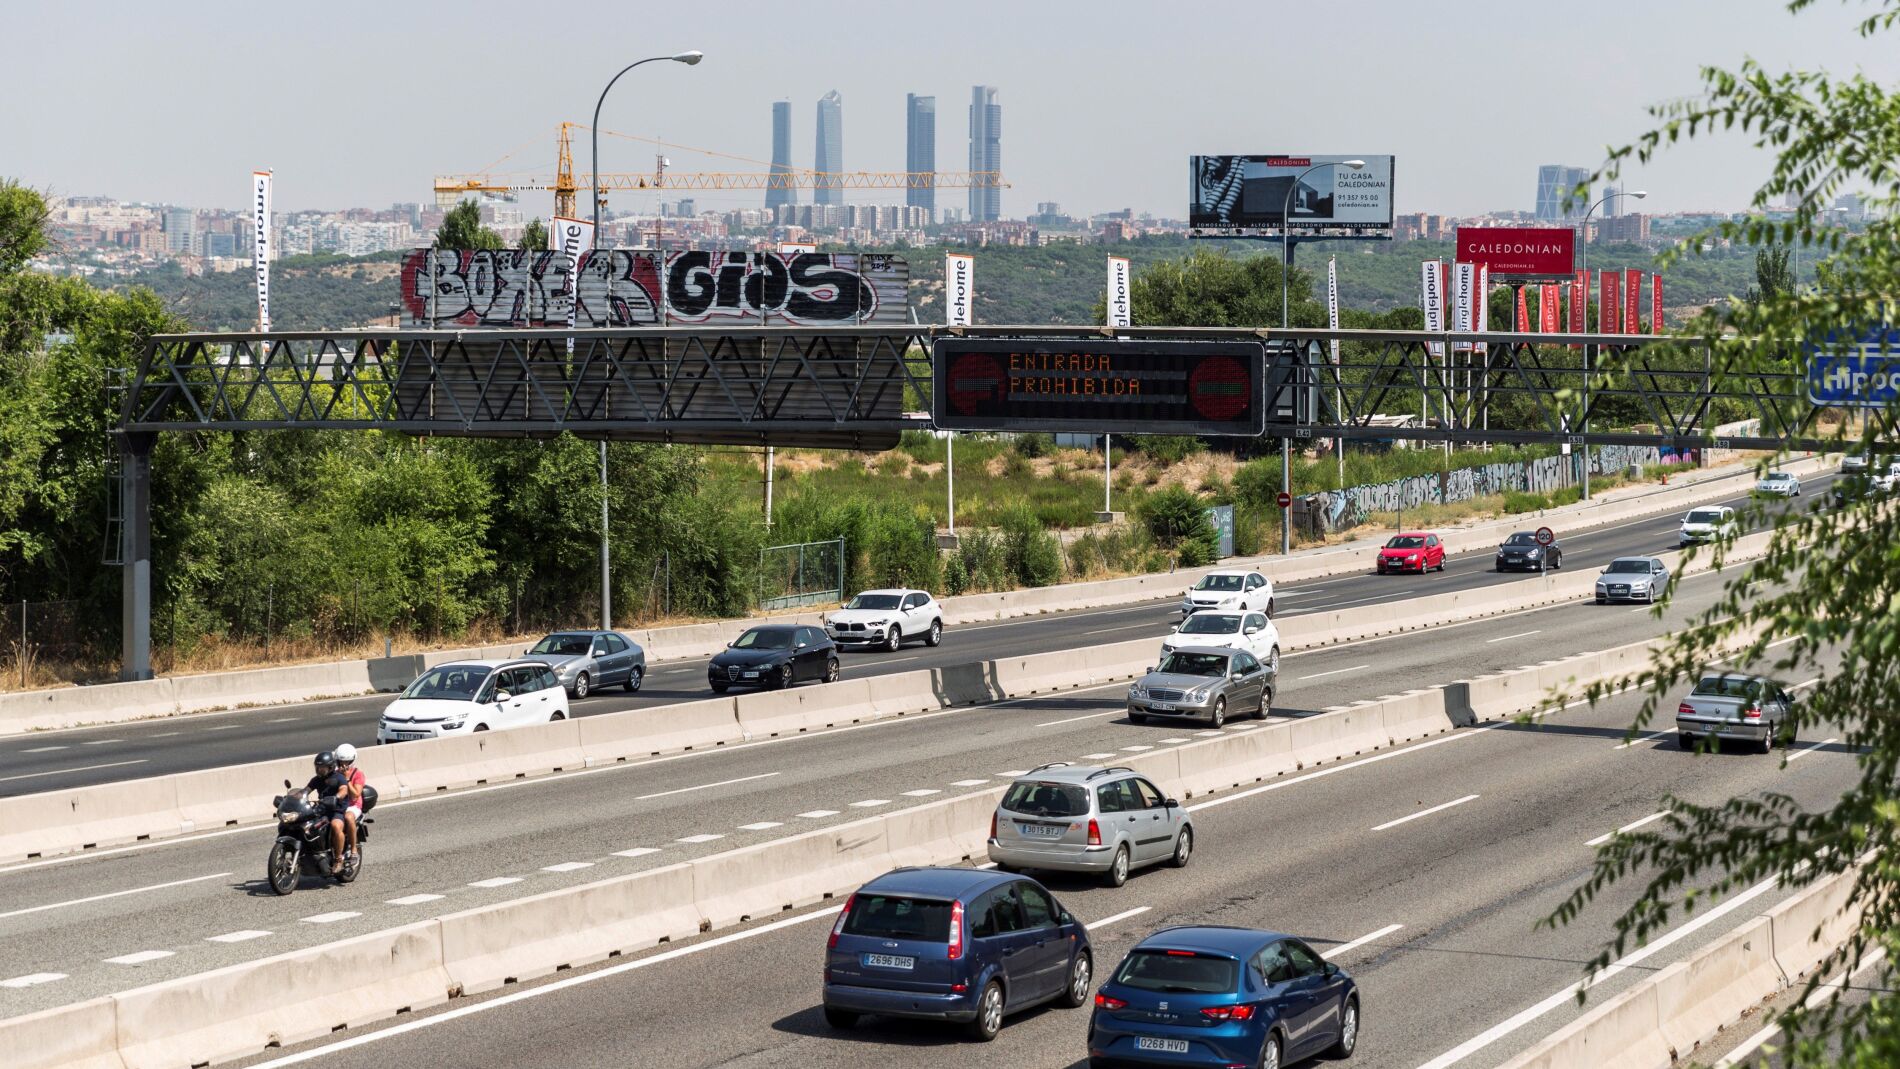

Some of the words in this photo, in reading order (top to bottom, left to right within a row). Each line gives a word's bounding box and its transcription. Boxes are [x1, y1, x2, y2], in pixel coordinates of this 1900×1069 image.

[1469, 243, 1562, 254] CALEDONIAN
[954, 260, 966, 326] lehome
[1009, 353, 1111, 372] ENTRADA
[1009, 377, 1140, 395] PROHIBIDA
[870, 955, 893, 965] 2696
[894, 958, 913, 967] DHS
[1140, 1038, 1164, 1049] 0268
[1167, 1040, 1186, 1051] HVD
